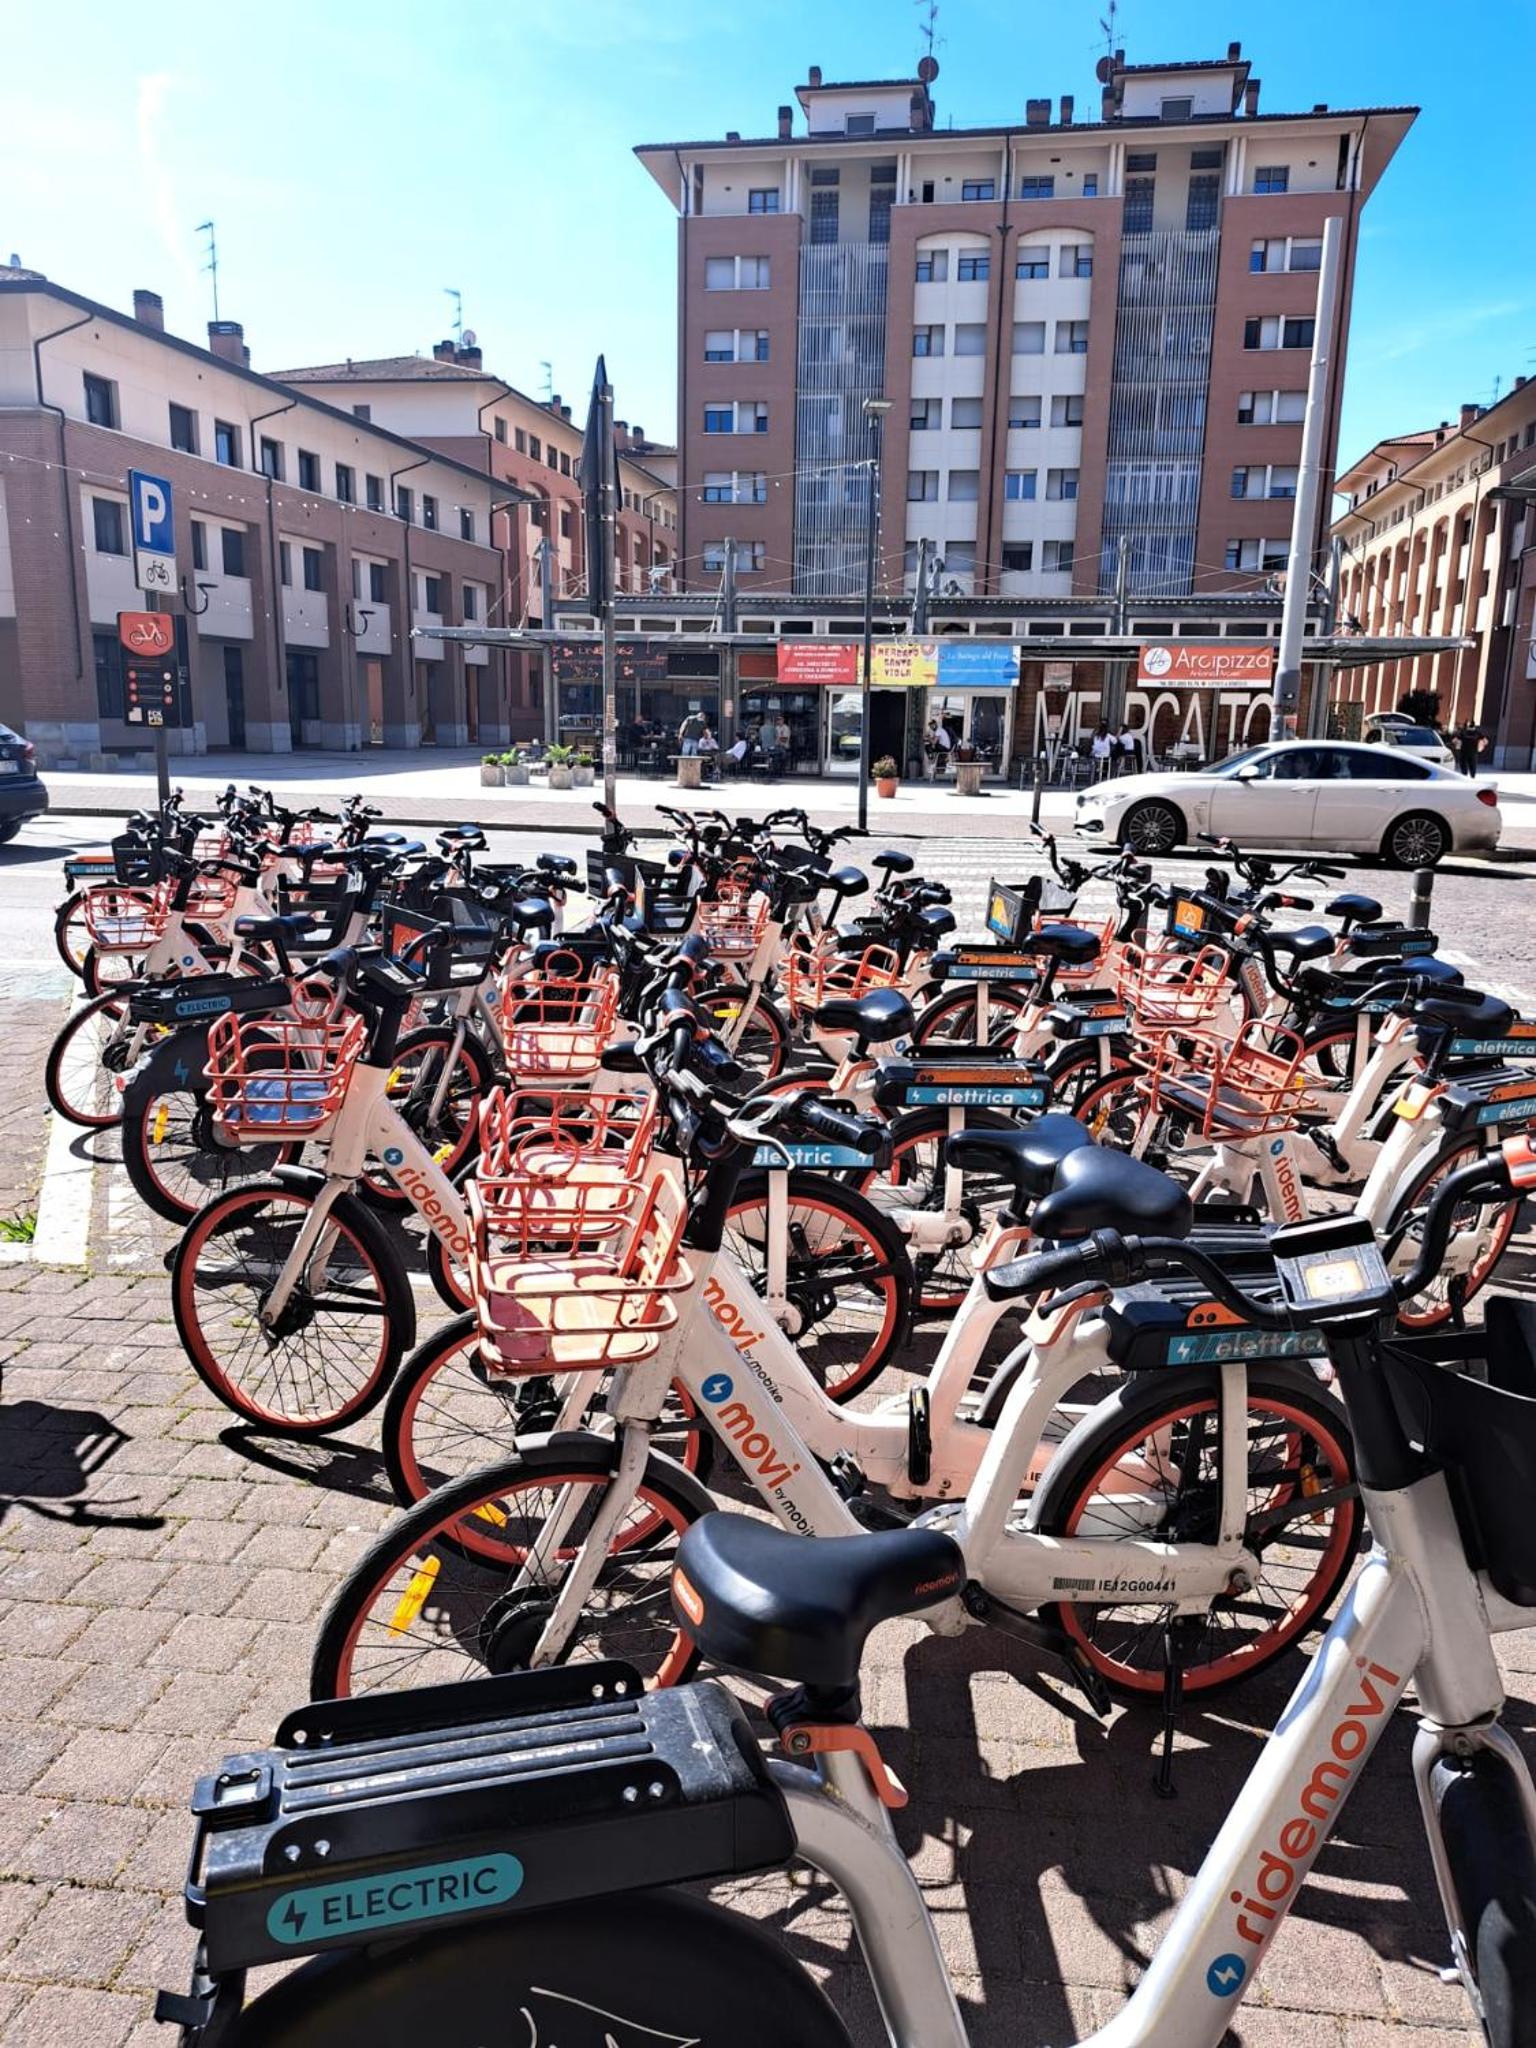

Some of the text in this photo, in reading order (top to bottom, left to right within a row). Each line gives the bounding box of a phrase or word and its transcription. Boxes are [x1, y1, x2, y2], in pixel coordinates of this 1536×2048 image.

[140, 480, 166, 542] P
[1175, 648, 1270, 676] Arcipizza
[971, 967, 1016, 977] electric
[1245, 964, 1267, 1011] ridemo
[1474, 1041, 1536, 1054] elettrica
[937, 1089, 1014, 1103] elettrica
[1499, 1101, 1536, 1119] electri
[753, 1147, 832, 1164] eletric
[397, 1168, 468, 1254] ridemo
[750, 1360, 783, 1403] mobike
[717, 1402, 801, 1489] movi
[774, 1488, 787, 1501] by
[1230, 1655, 1399, 1945] ridemovi
[323, 1867, 498, 1925] ELECTRIC
